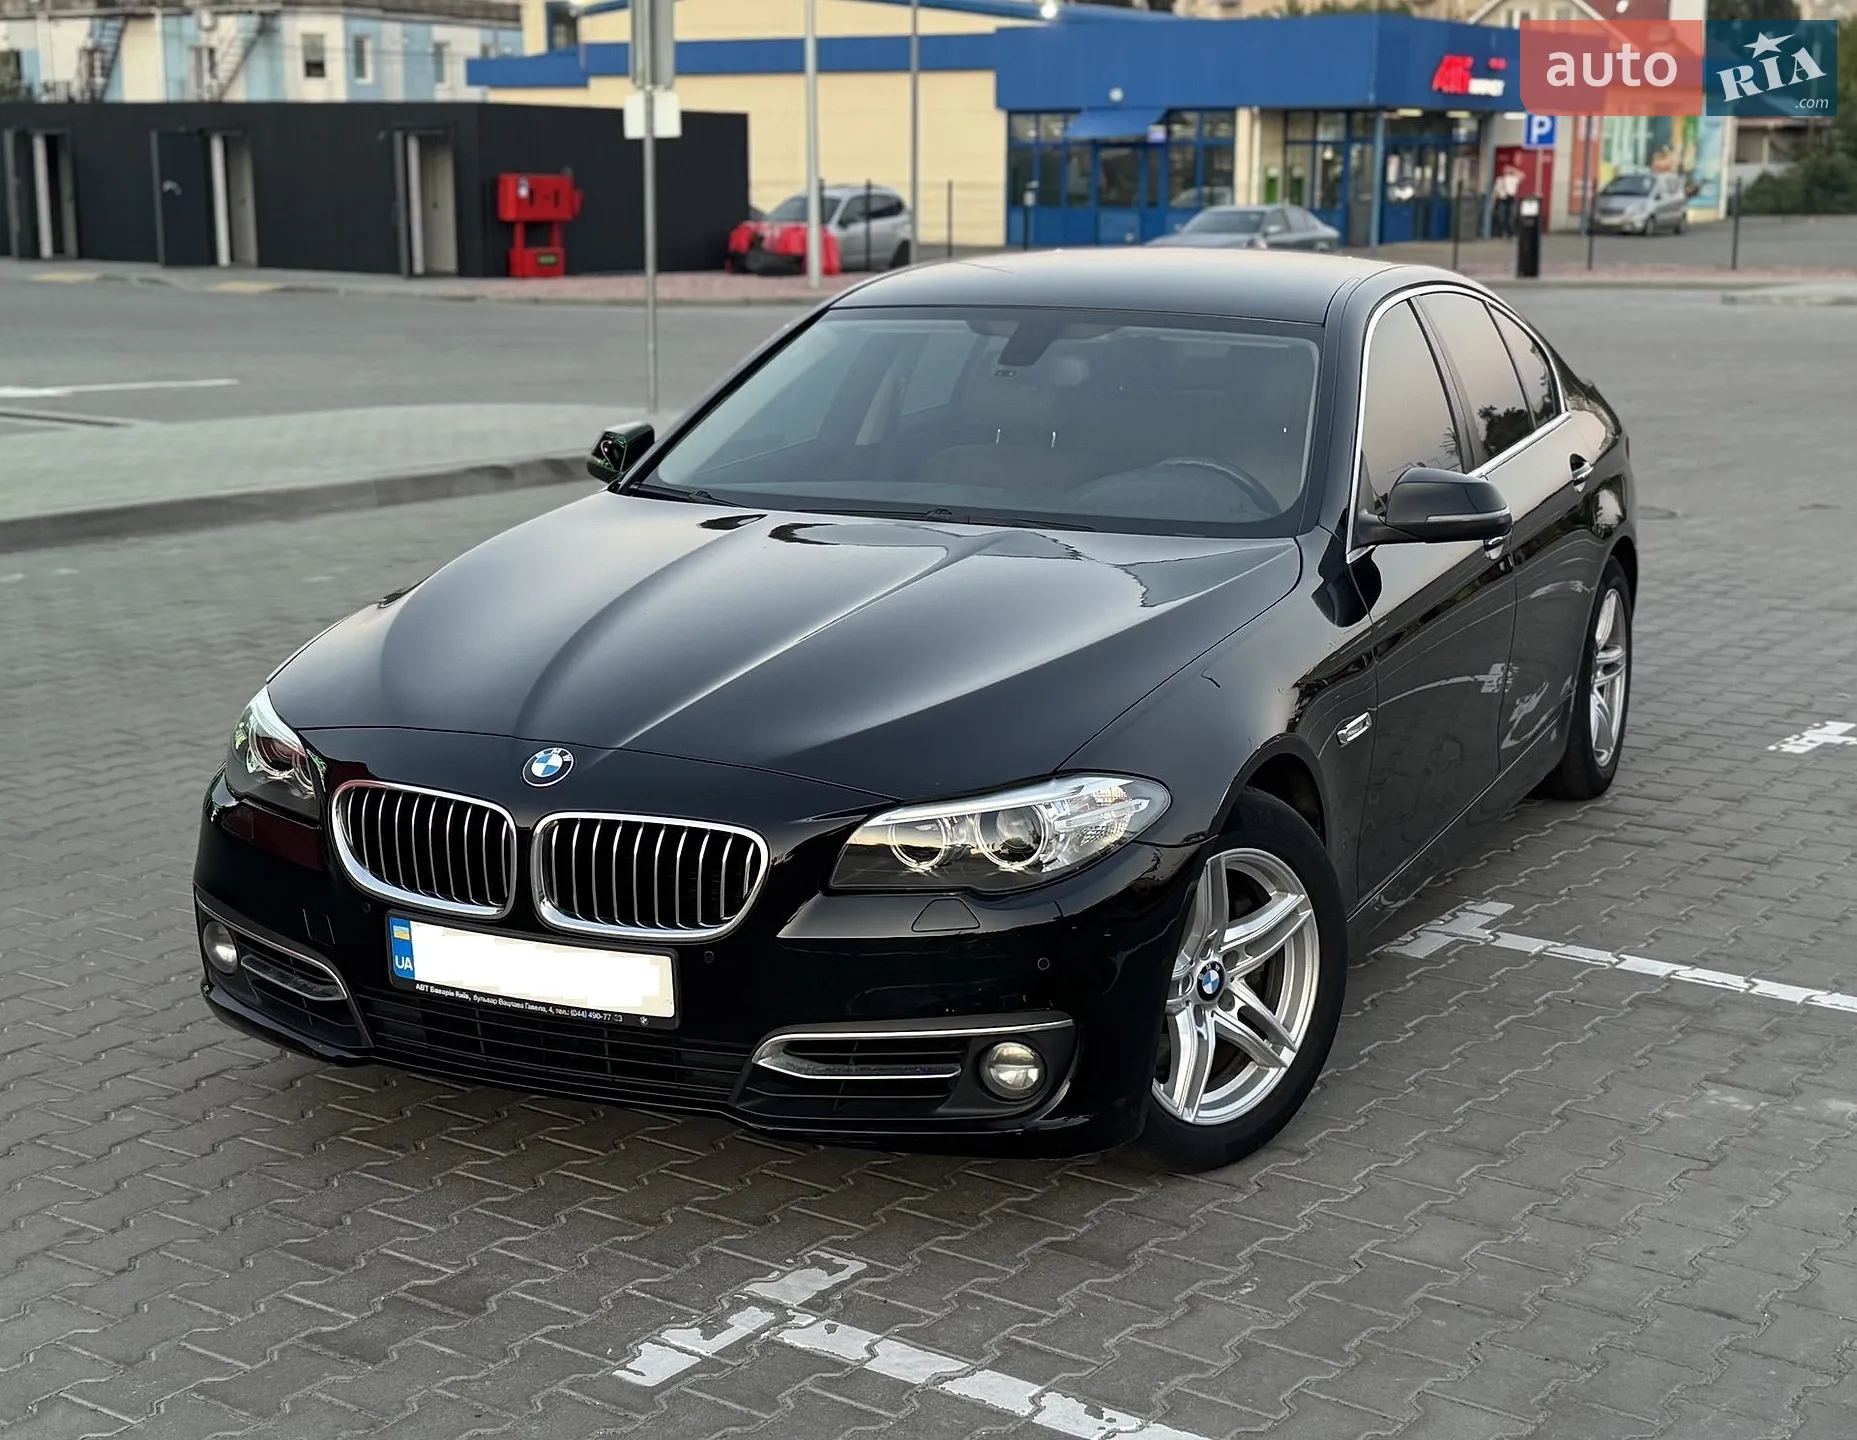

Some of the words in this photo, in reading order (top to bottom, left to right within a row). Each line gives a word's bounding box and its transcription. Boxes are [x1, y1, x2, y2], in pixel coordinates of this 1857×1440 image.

[1531, 113, 1552, 143] P
[395, 955, 413, 971] UA
[570, 1009, 588, 1019] (044)
